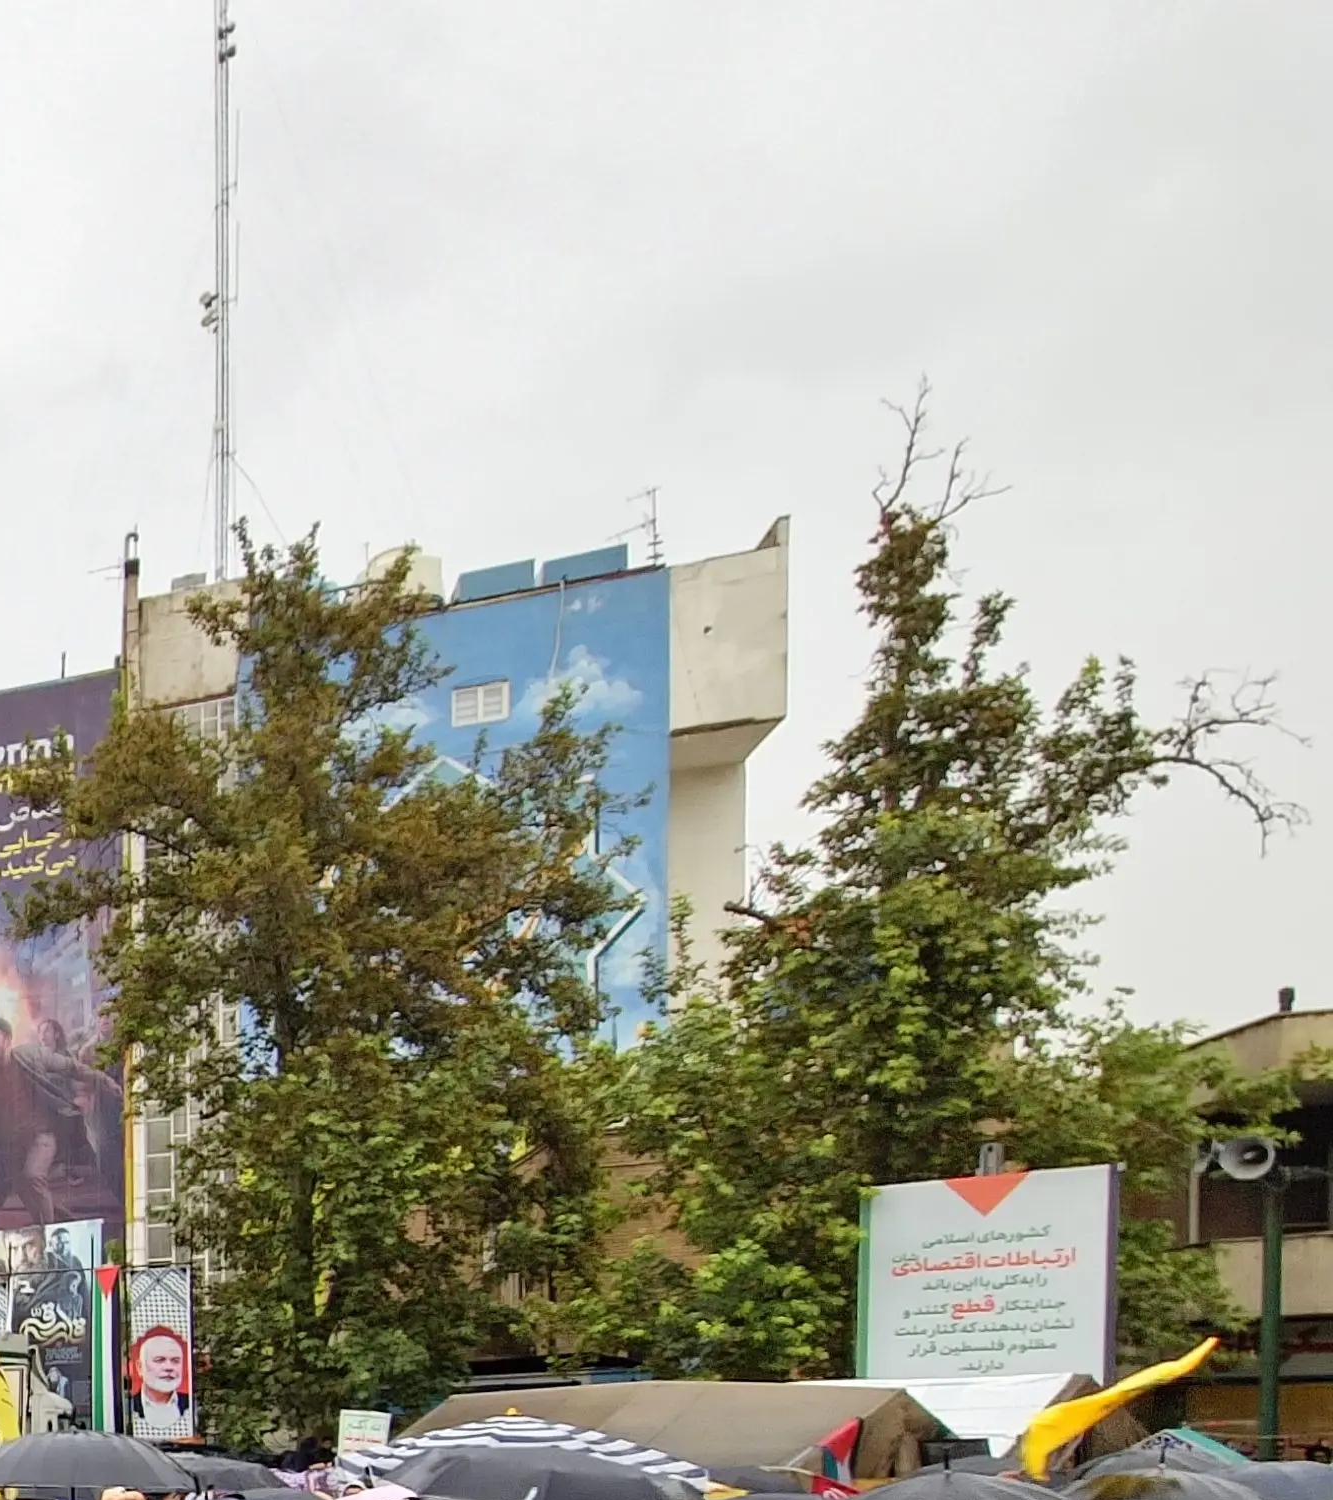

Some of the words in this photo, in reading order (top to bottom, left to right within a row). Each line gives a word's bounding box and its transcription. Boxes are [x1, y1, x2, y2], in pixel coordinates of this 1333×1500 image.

[922, 1231, 975, 1249] اسلامی
[978, 1224, 1052, 1245] کشورهای
[891, 1250, 983, 1278] اقتصادی
[984, 1246, 1077, 1269] ارتباطات
[950, 1294, 996, 1321] قطع
[996, 1297, 1066, 1316] جنایتکار
[979, 1320, 1027, 1335] بدهند
[1030, 1317, 1075, 1334] نشان
[907, 1341, 937, 1358] قرار
[940, 1339, 1006, 1357] فلسطین
[1007, 1337, 1058, 1355] مظلوم
